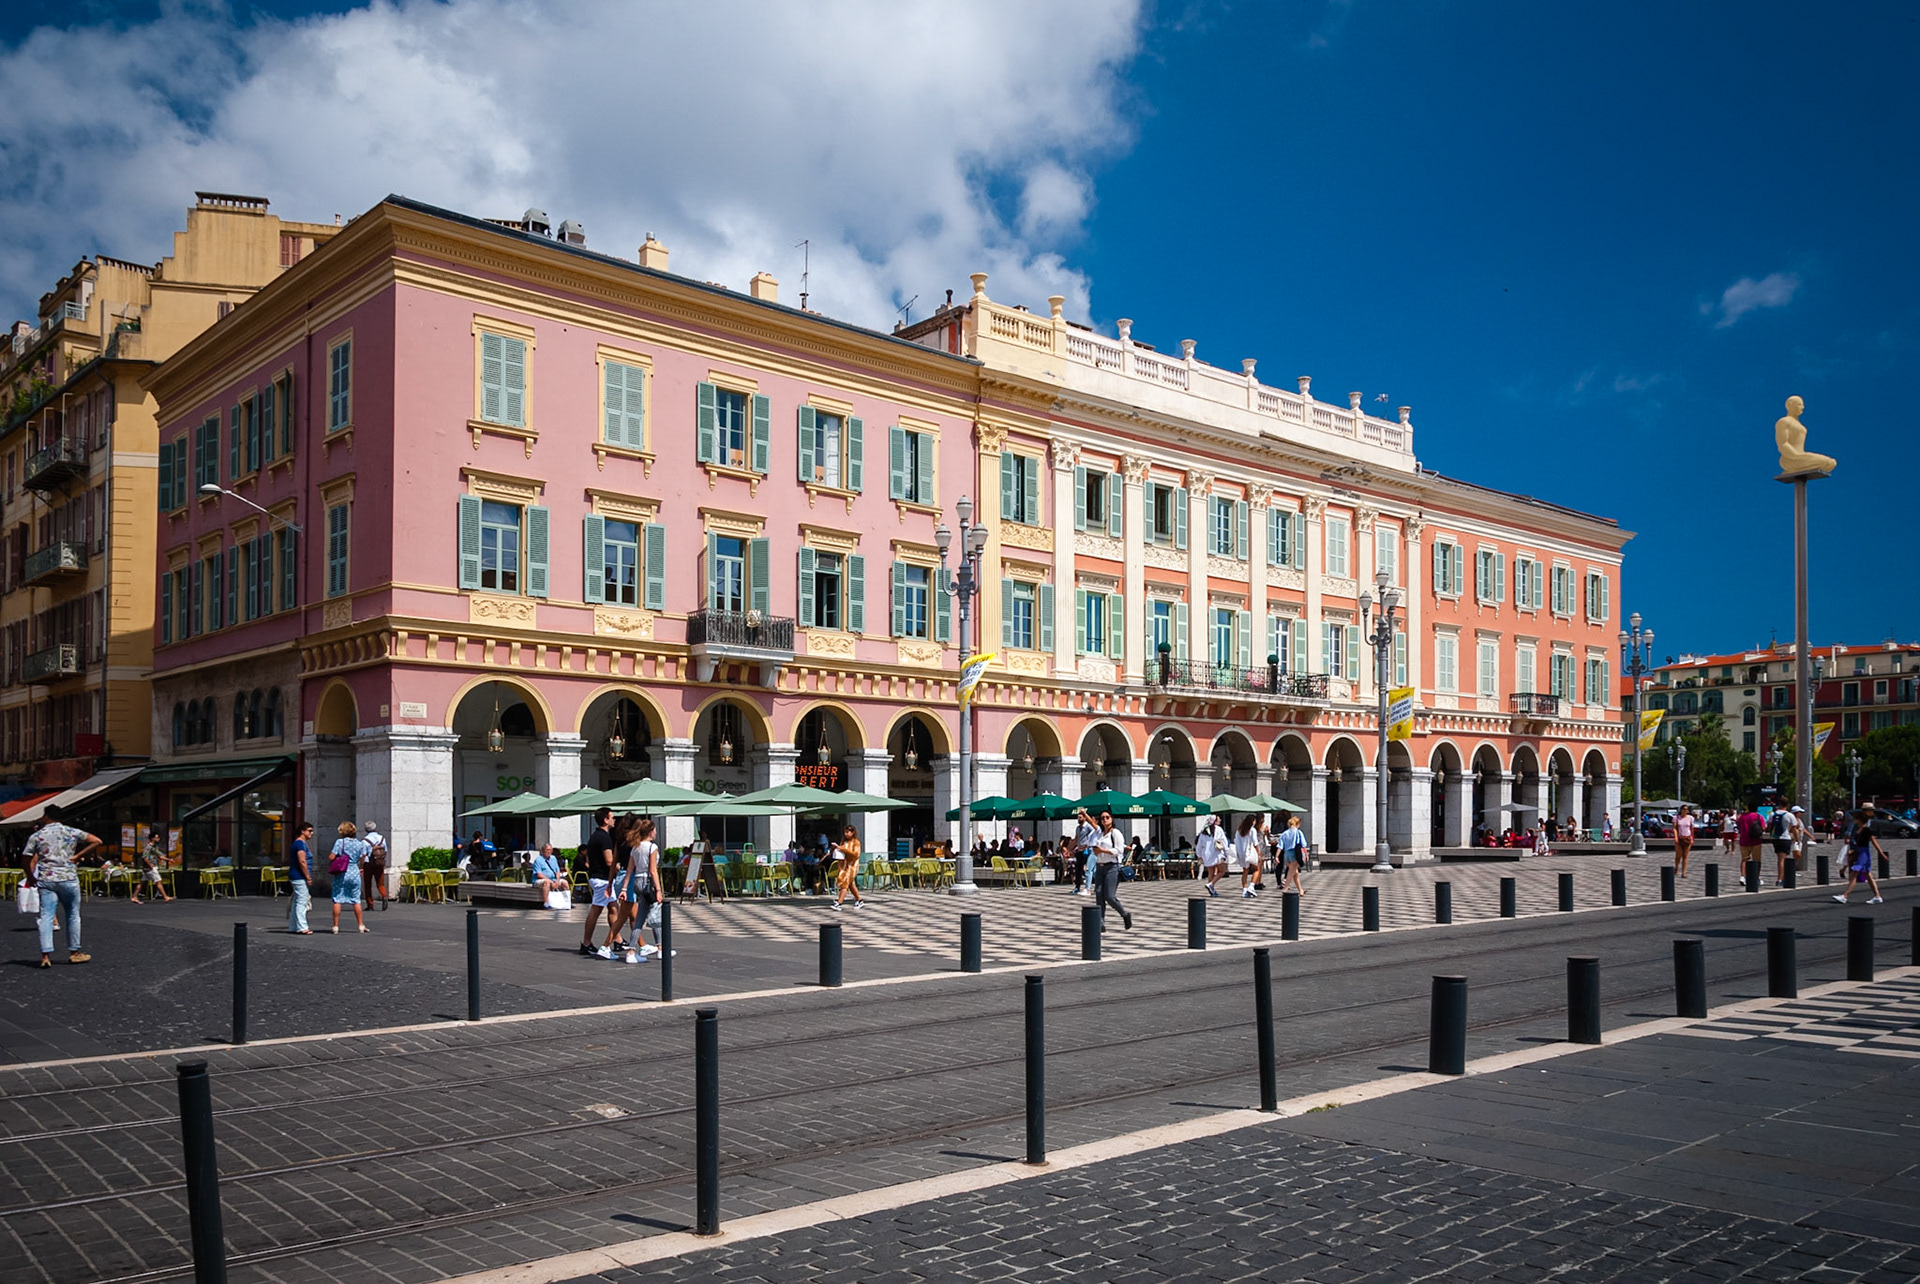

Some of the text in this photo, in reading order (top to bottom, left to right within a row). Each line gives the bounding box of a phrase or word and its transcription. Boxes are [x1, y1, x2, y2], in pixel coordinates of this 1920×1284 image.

[795, 765, 838, 776] ONSIEUR
[497, 775, 521, 791] SO
[695, 779, 747, 793] SO Green
[800, 775, 838, 788] BERT
